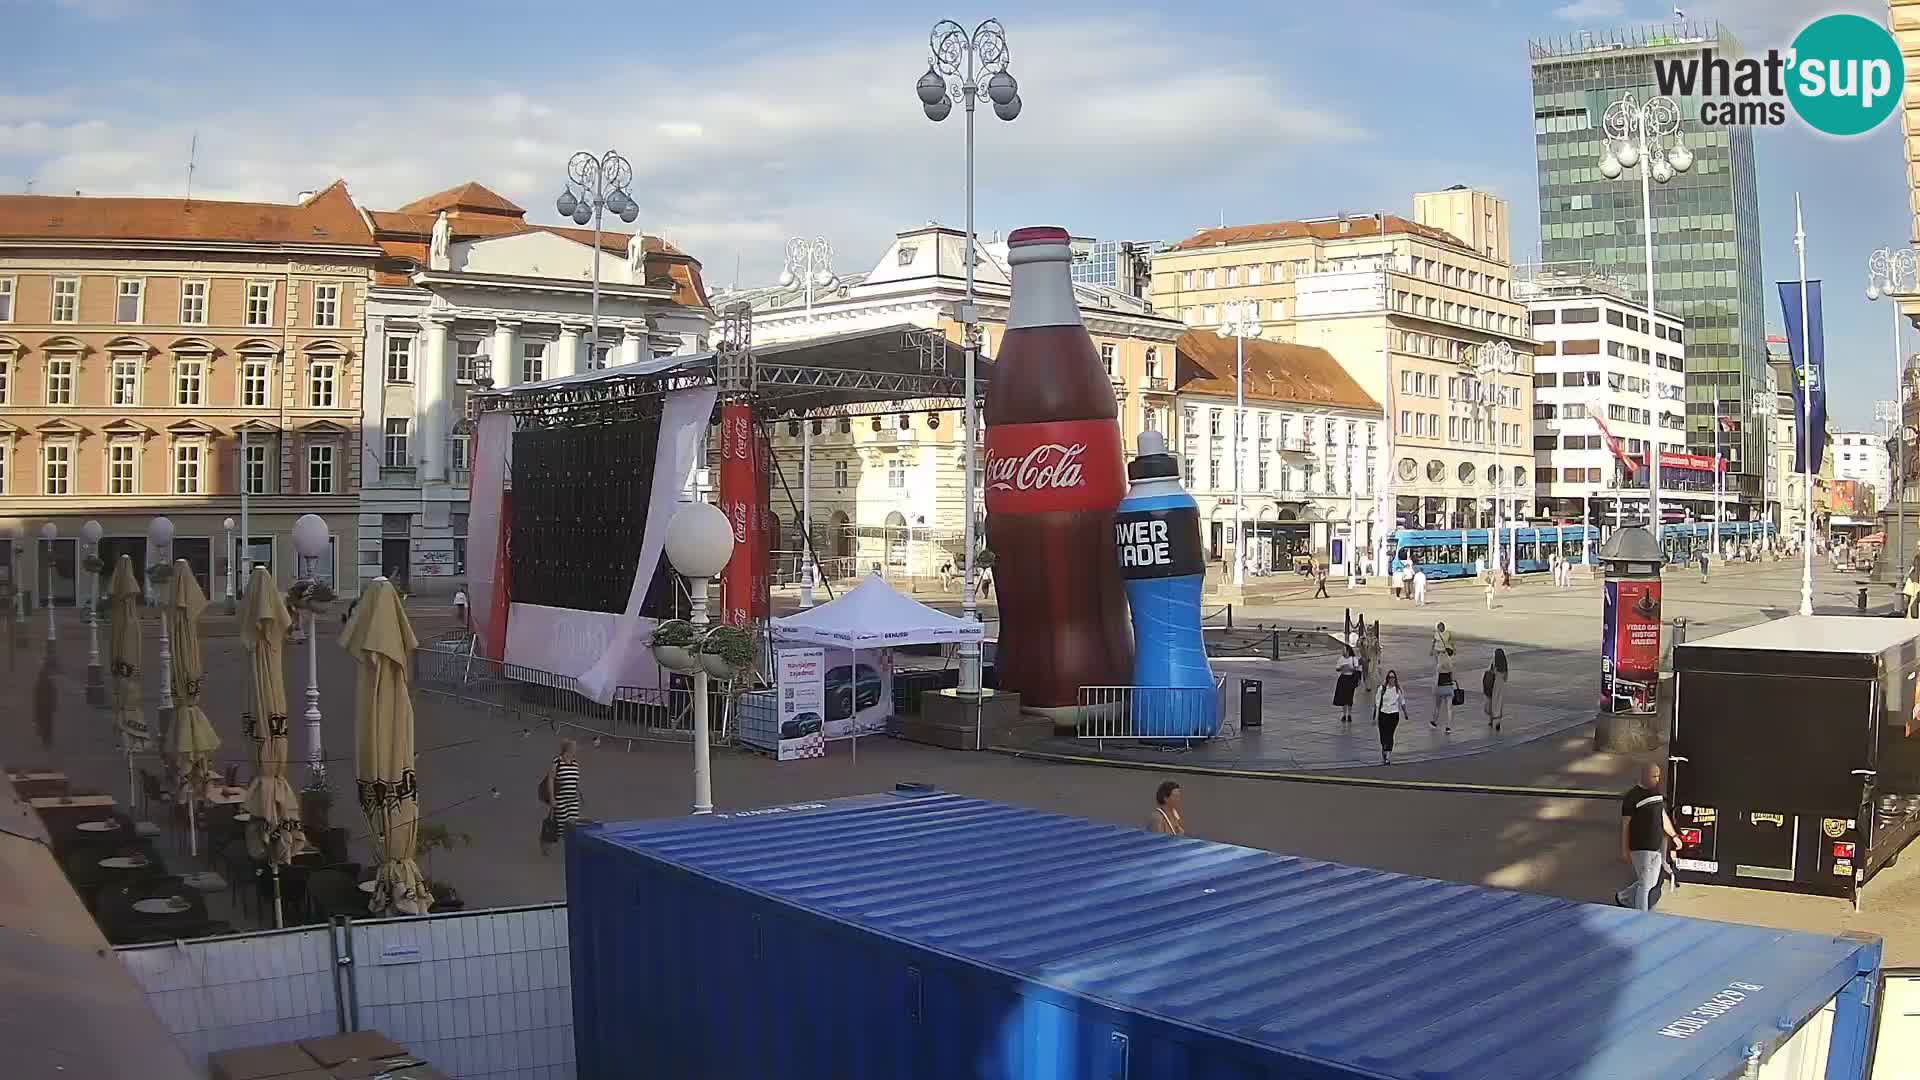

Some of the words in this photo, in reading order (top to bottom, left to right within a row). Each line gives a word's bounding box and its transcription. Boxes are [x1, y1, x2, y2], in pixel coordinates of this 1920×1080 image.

[735, 416, 748, 459] Coca-Cola
[734, 500, 747, 544] Coca-Cola
[1115, 520, 1169, 545] WER
[1692, 989, 1748, 1018] 300629
